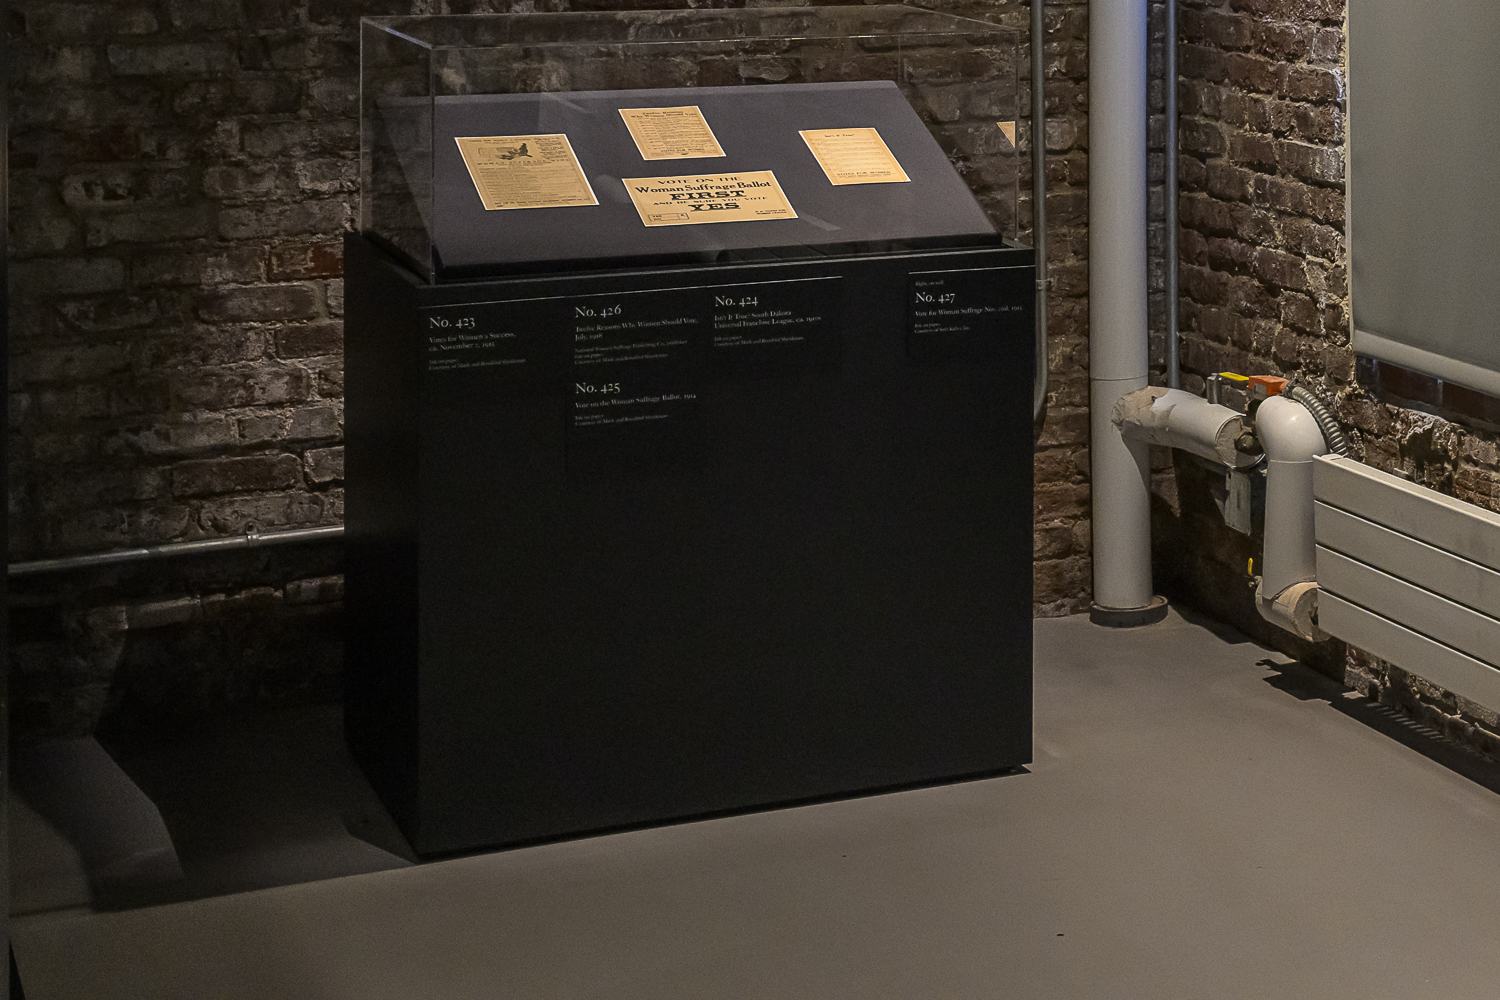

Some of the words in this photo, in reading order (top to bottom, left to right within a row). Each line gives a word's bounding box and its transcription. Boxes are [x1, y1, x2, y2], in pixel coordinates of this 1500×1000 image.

[685, 183, 736, 192] Suffrage
[669, 190, 747, 200] FIRST
[688, 203, 741, 212] YES
[715, 296, 735, 307] No.
[739, 296, 758, 307] 424
[915, 292, 935, 303] No.
[938, 293, 955, 304] 427
[575, 306, 597, 318] No.
[600, 304, 622, 318] 426
[429, 317, 452, 328] No.
[456, 317, 475, 329] 423
[715, 321, 742, 329] Universal
[575, 382, 597, 394] No.
[600, 383, 620, 394] 425
